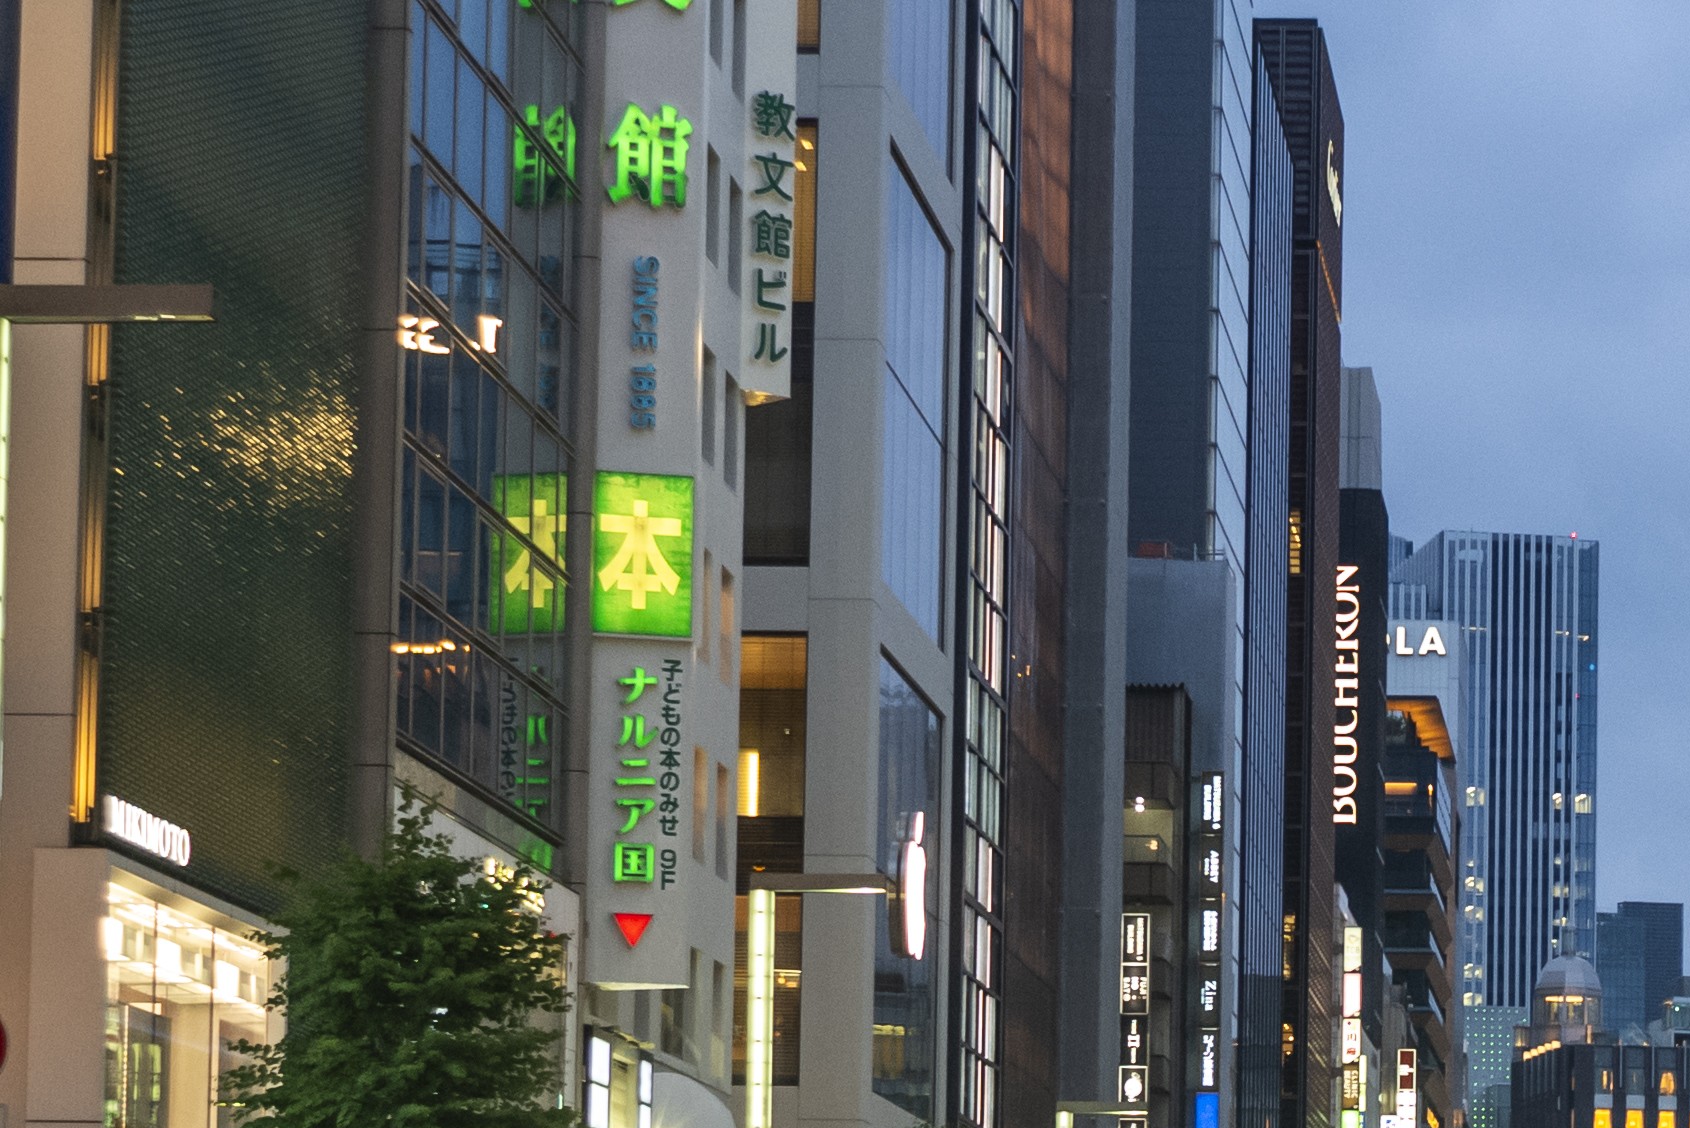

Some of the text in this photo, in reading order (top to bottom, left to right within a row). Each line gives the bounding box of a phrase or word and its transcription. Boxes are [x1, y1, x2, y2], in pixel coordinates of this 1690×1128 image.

[753, 90, 796, 364] 教文館ビル
[631, 256, 660, 353] SINCE
[597, 499, 682, 610] 本
[1386, 626, 1447, 656] LA
[1333, 564, 1361, 825] BOUCHERON
[613, 666, 659, 882] ナルニア国
[660, 659, 683, 890] 子どもの本のみせ 9F
[103, 794, 190, 867] MIKIMOTO
[1343, 1070, 1351, 1099] BEAUTY
[1351, 1070, 1359, 1099] CLINIC
